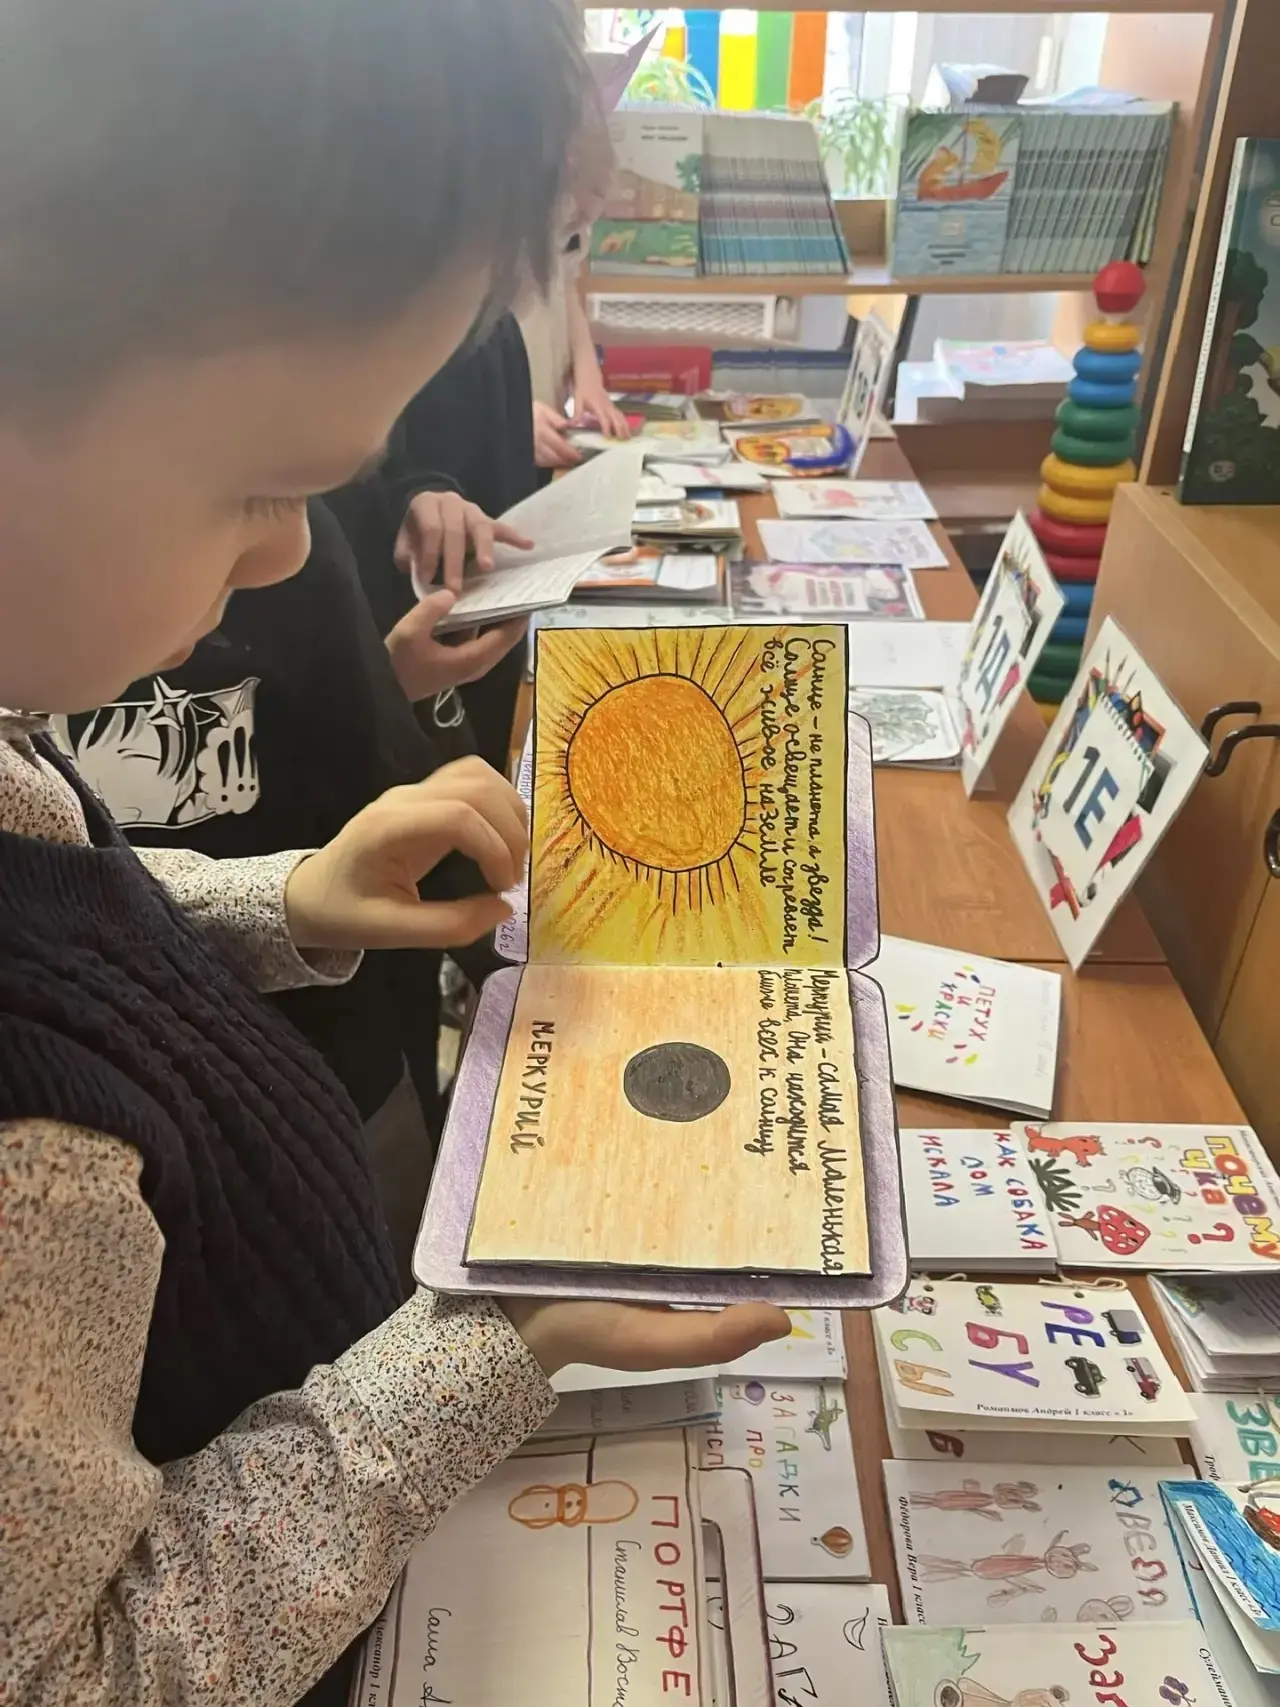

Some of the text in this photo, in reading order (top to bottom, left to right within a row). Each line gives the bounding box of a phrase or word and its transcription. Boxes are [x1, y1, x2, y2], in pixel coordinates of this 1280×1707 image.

[760, 636, 784, 673] всё
[806, 639, 836, 711] Солнце
[760, 684, 781, 771] живое
[808, 733, 824, 755] не
[775, 637, 811, 955] Солнце освещает и согревает
[808, 844, 822, 860] а
[758, 970, 782, 1010] ближе
[927, 981, 958, 1041] КРАСКИ
[968, 984, 996, 1041] ПЕТУХ
[757, 1017, 782, 1062] всех
[786, 1031, 811, 1064] Она
[510, 1020, 556, 1154] МЕРКУРИЙ
[758, 1067, 777, 1081] к
[817, 1062, 845, 1133] самая
[775, 1072, 811, 1175] находится
[918, 1135, 961, 1207] ИСКАЛА
[960, 1156, 995, 1196] ДОМ
[993, 1132, 1049, 1250] КАК СОБАКА
[817, 1140, 847, 1275] Маленькая
[964, 1321, 1041, 1388] БУ
[1040, 1300, 1107, 1348] РЕ
[1082, 1409, 1112, 1417] класс
[745, 1428, 766, 1469] ПРО
[770, 1390, 802, 1523] ЗАГАДКИ
[613, 1539, 642, 1637] Станислав
[898, 1496, 914, 1551] Фёдорова
[906, 1553, 918, 1582] Вера
[914, 1593, 926, 1625] класс
[651, 1495, 692, 1697] ПОРТФЕ
[423, 1607, 452, 1672] Саша
